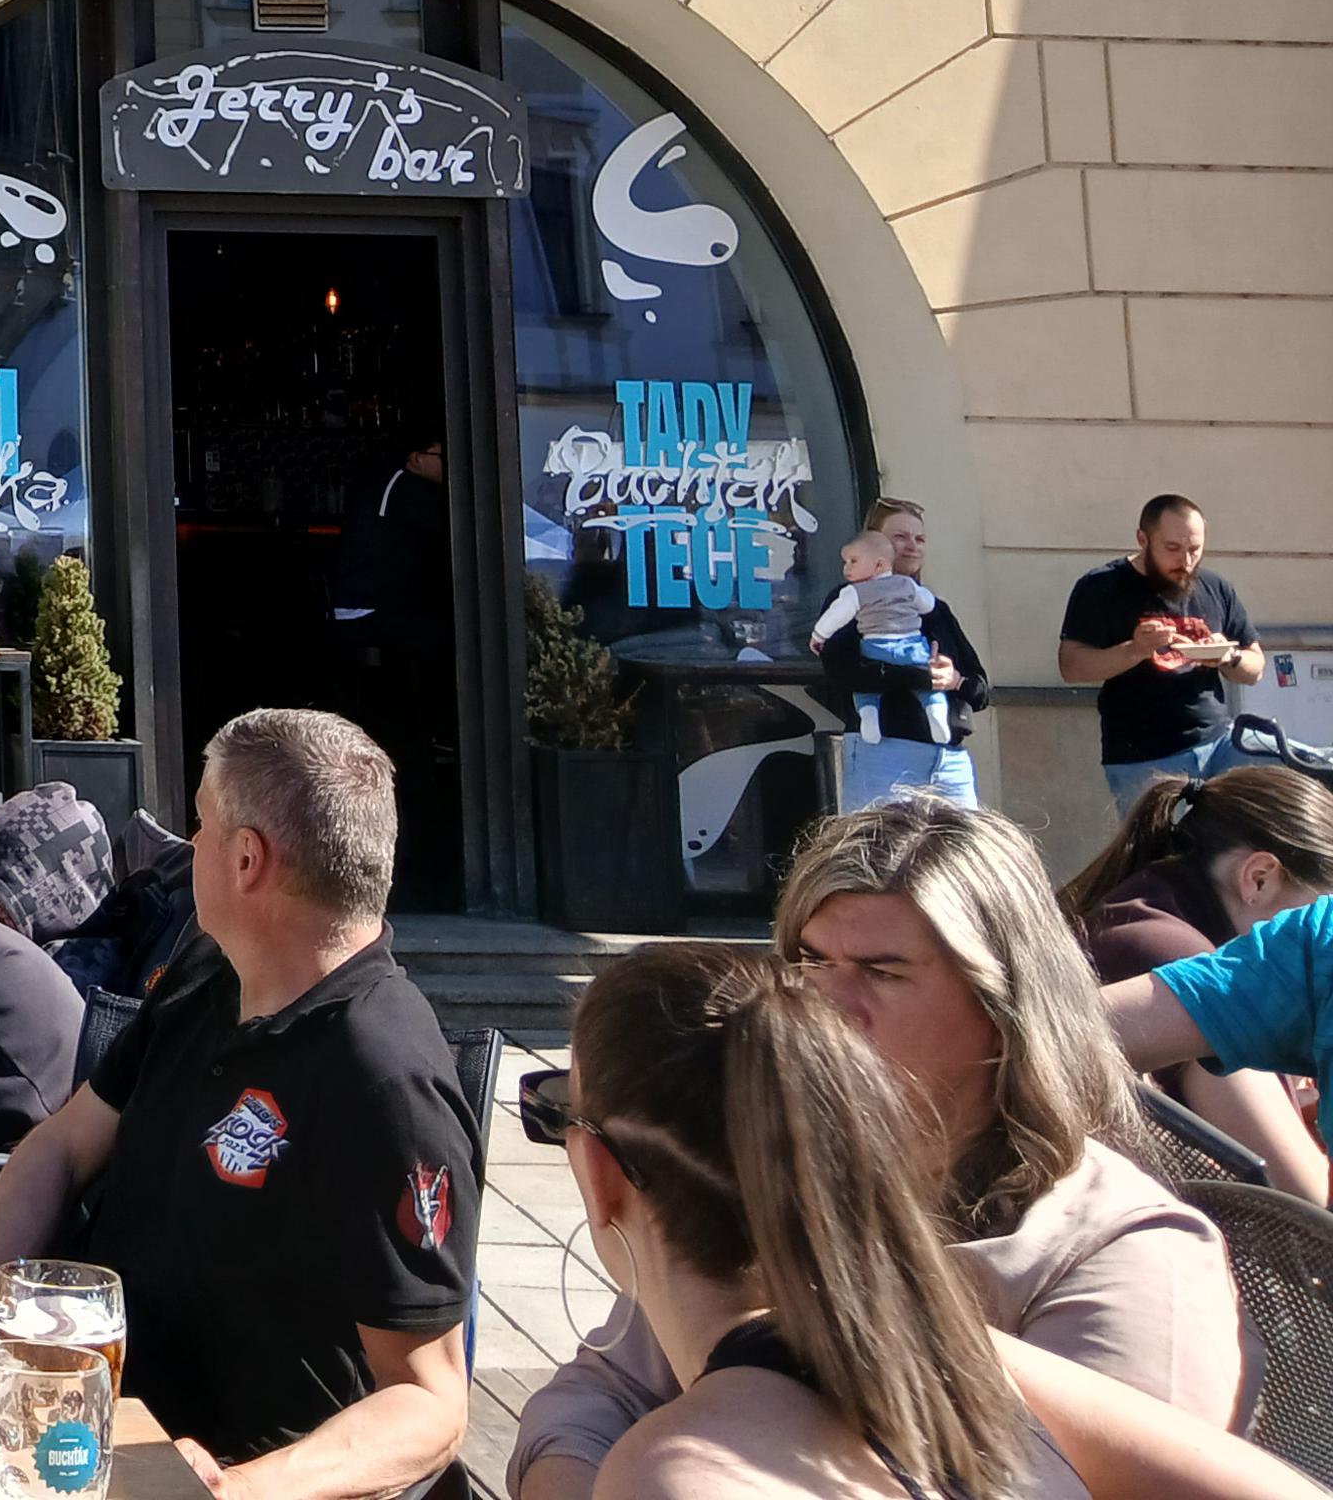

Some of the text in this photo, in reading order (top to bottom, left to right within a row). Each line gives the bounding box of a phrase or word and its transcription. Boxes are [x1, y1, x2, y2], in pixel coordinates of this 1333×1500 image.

[156, 65, 423, 150] Jerry's
[368, 123, 475, 185] bar
[615, 380, 753, 470] TADY
[203, 1113, 289, 1168] ROCK
